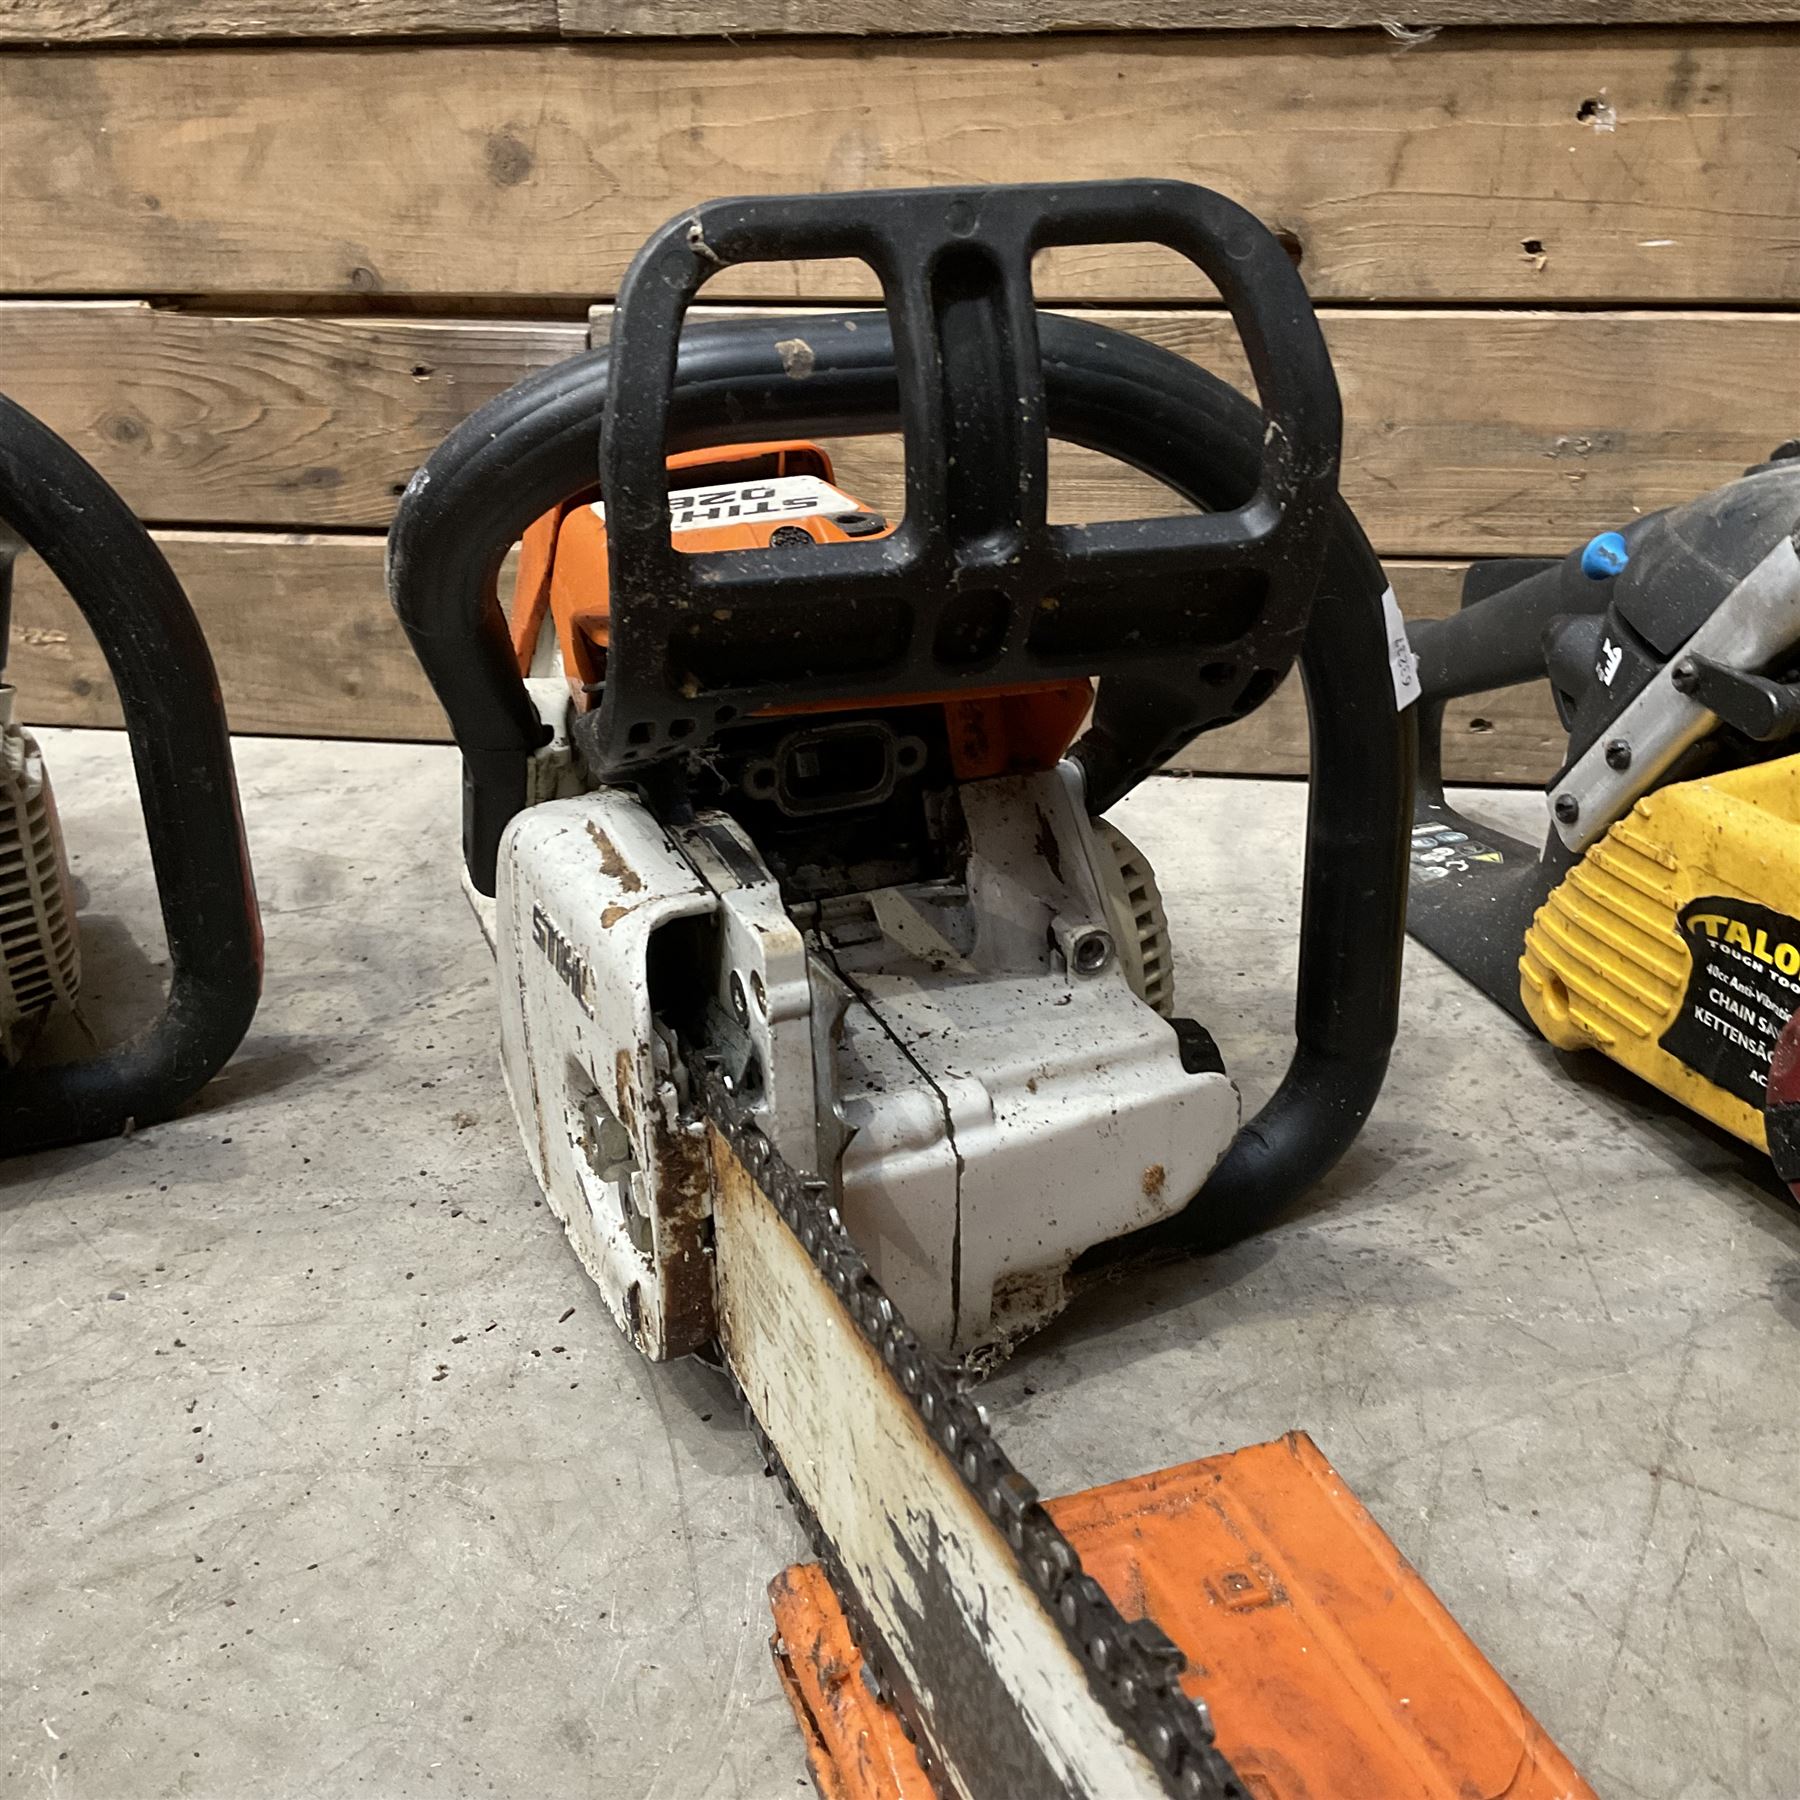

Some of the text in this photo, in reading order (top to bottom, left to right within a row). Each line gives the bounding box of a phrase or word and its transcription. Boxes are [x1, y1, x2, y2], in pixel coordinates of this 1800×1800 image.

[681, 496, 818, 523] STIH
[1686, 913, 1800, 979] TALO
[1707, 938, 1800, 994] TOUGH TOO
[1709, 988, 1756, 1026] CHAIN
